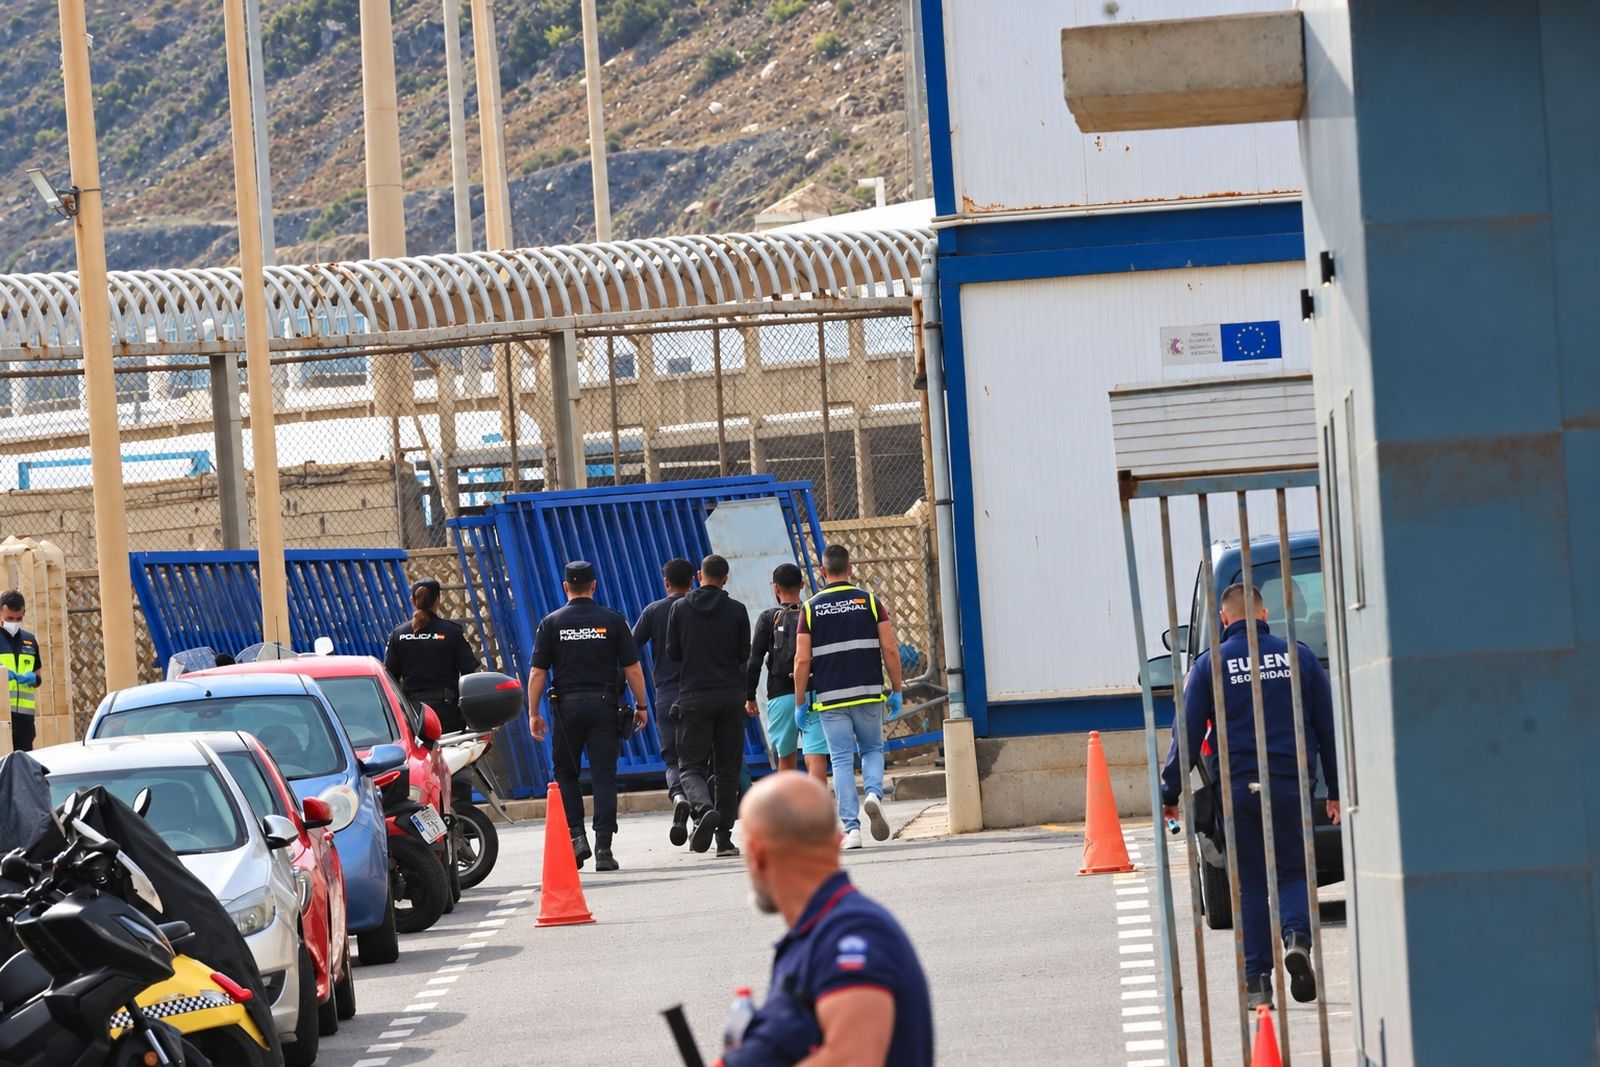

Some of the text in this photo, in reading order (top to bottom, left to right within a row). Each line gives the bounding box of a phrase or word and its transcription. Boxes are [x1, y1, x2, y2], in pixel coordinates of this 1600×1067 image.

[815, 599, 855, 610] POLICIA
[815, 604, 867, 617] NACIONAL
[559, 627, 597, 635] POLICIA
[560, 633, 607, 641] NACIONAL
